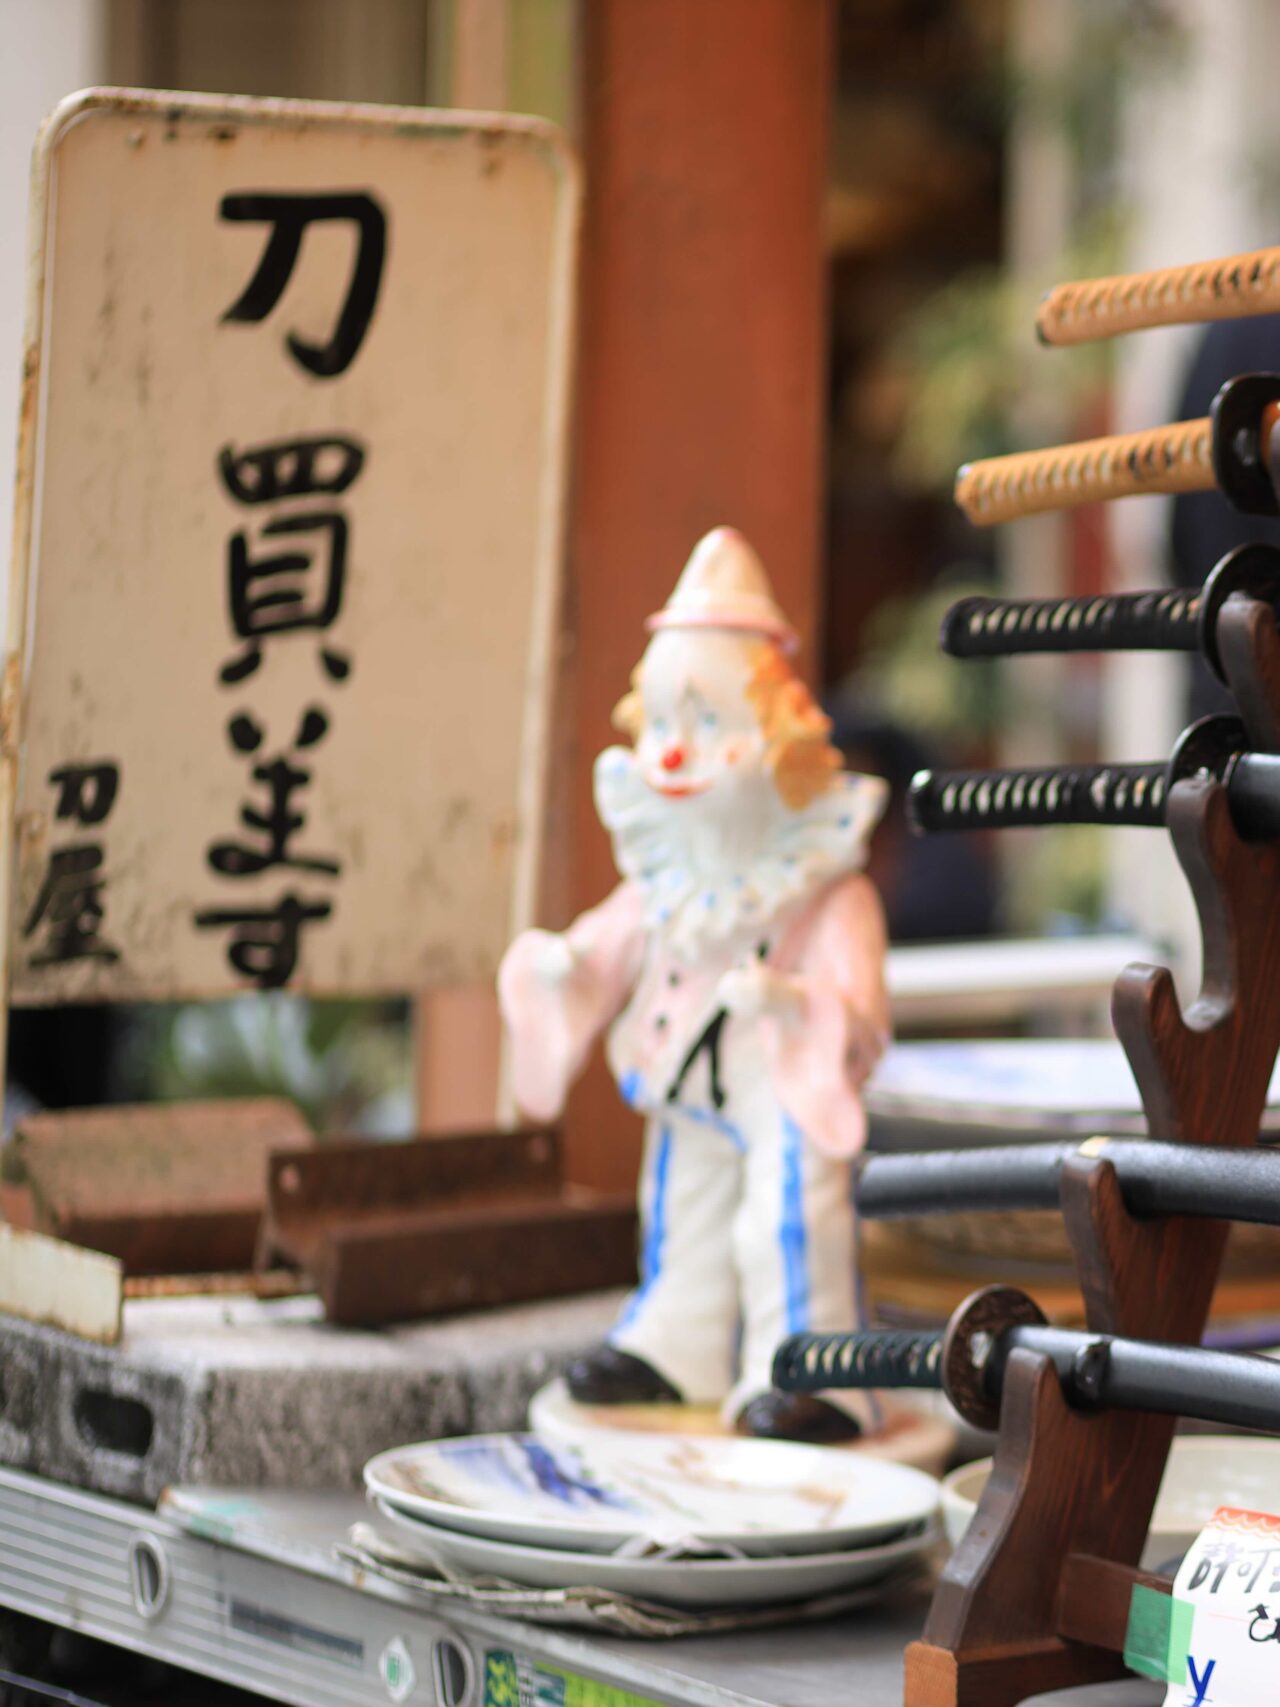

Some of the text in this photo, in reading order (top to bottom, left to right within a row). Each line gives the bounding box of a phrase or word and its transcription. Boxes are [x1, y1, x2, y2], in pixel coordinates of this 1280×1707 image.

[194, 188, 390, 990] 刀買います
[22, 760, 120, 968] 刀屋
